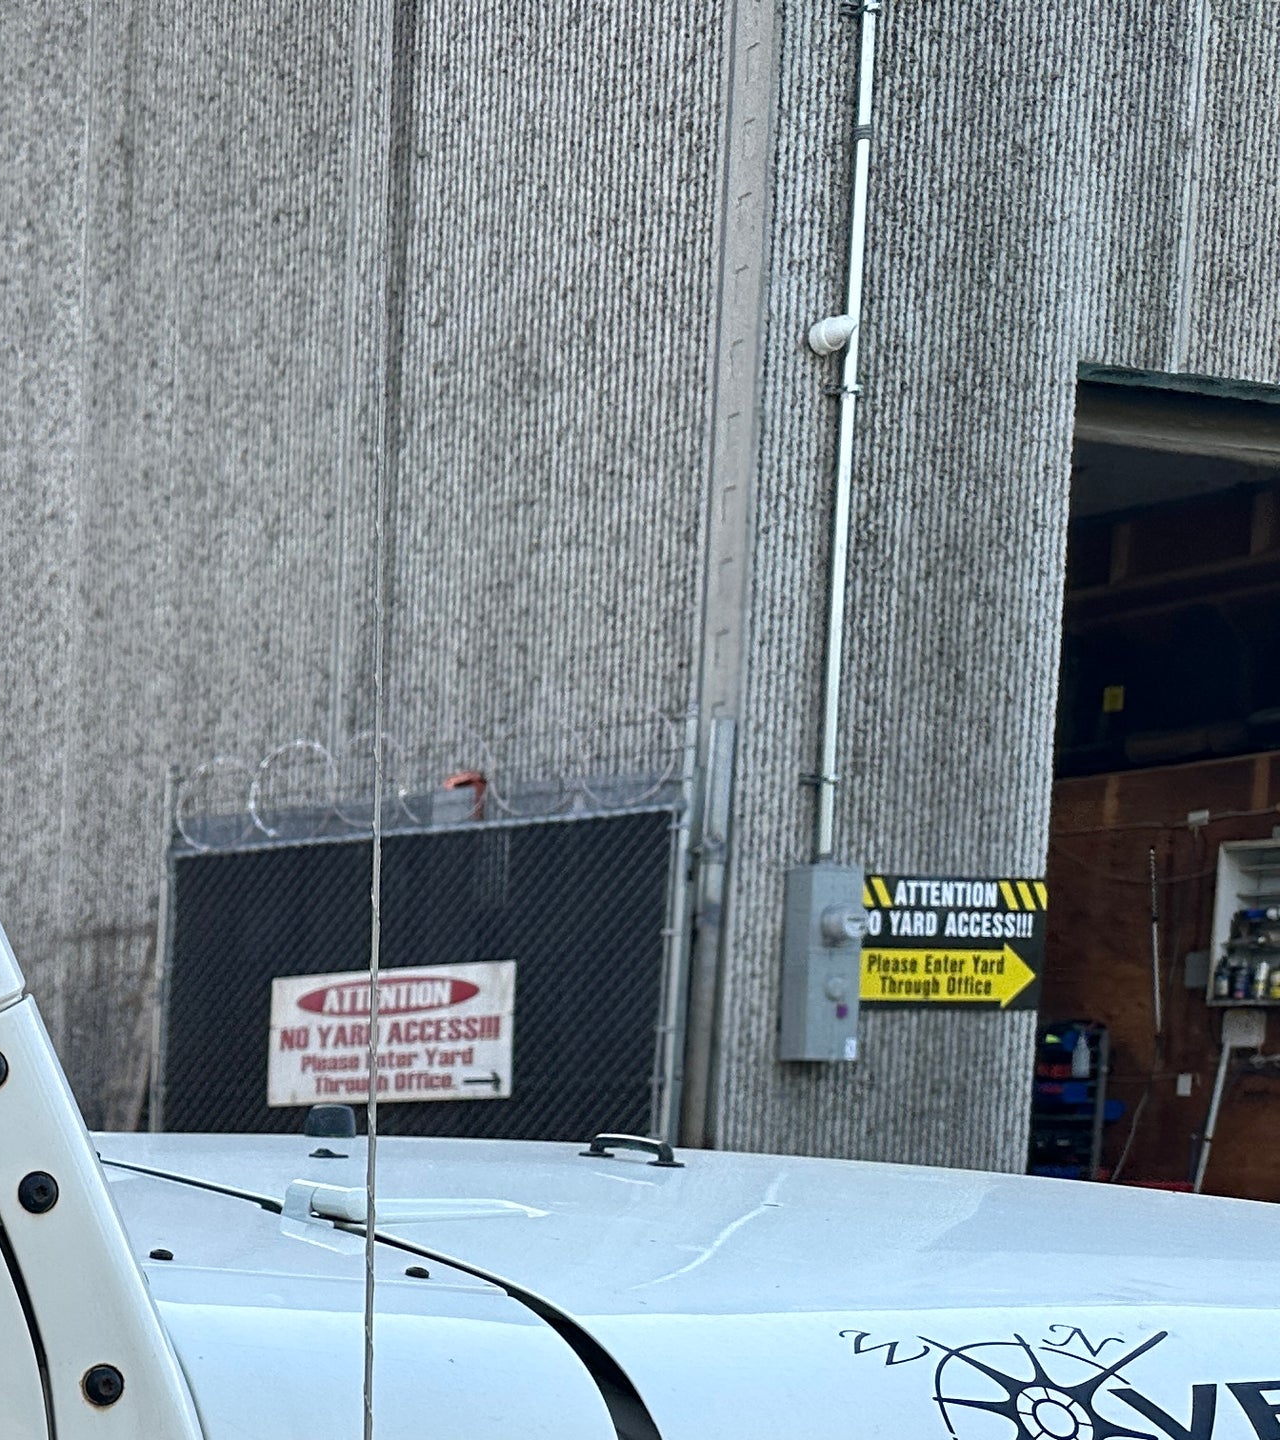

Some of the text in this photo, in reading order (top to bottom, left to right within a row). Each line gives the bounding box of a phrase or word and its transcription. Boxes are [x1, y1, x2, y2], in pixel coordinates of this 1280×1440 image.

[894, 880, 998, 908] ATTENTION
[868, 911, 1033, 938] O YARD ACCESS!!!
[867, 953, 1006, 976] Please Enter Yard
[881, 975, 993, 1000] Through Office
[280, 1026, 310, 1050] NO
[386, 1015, 501, 1045] ACCESS!!!
[301, 1053, 359, 1073] Please
[424, 1046, 474, 1066] Yard
